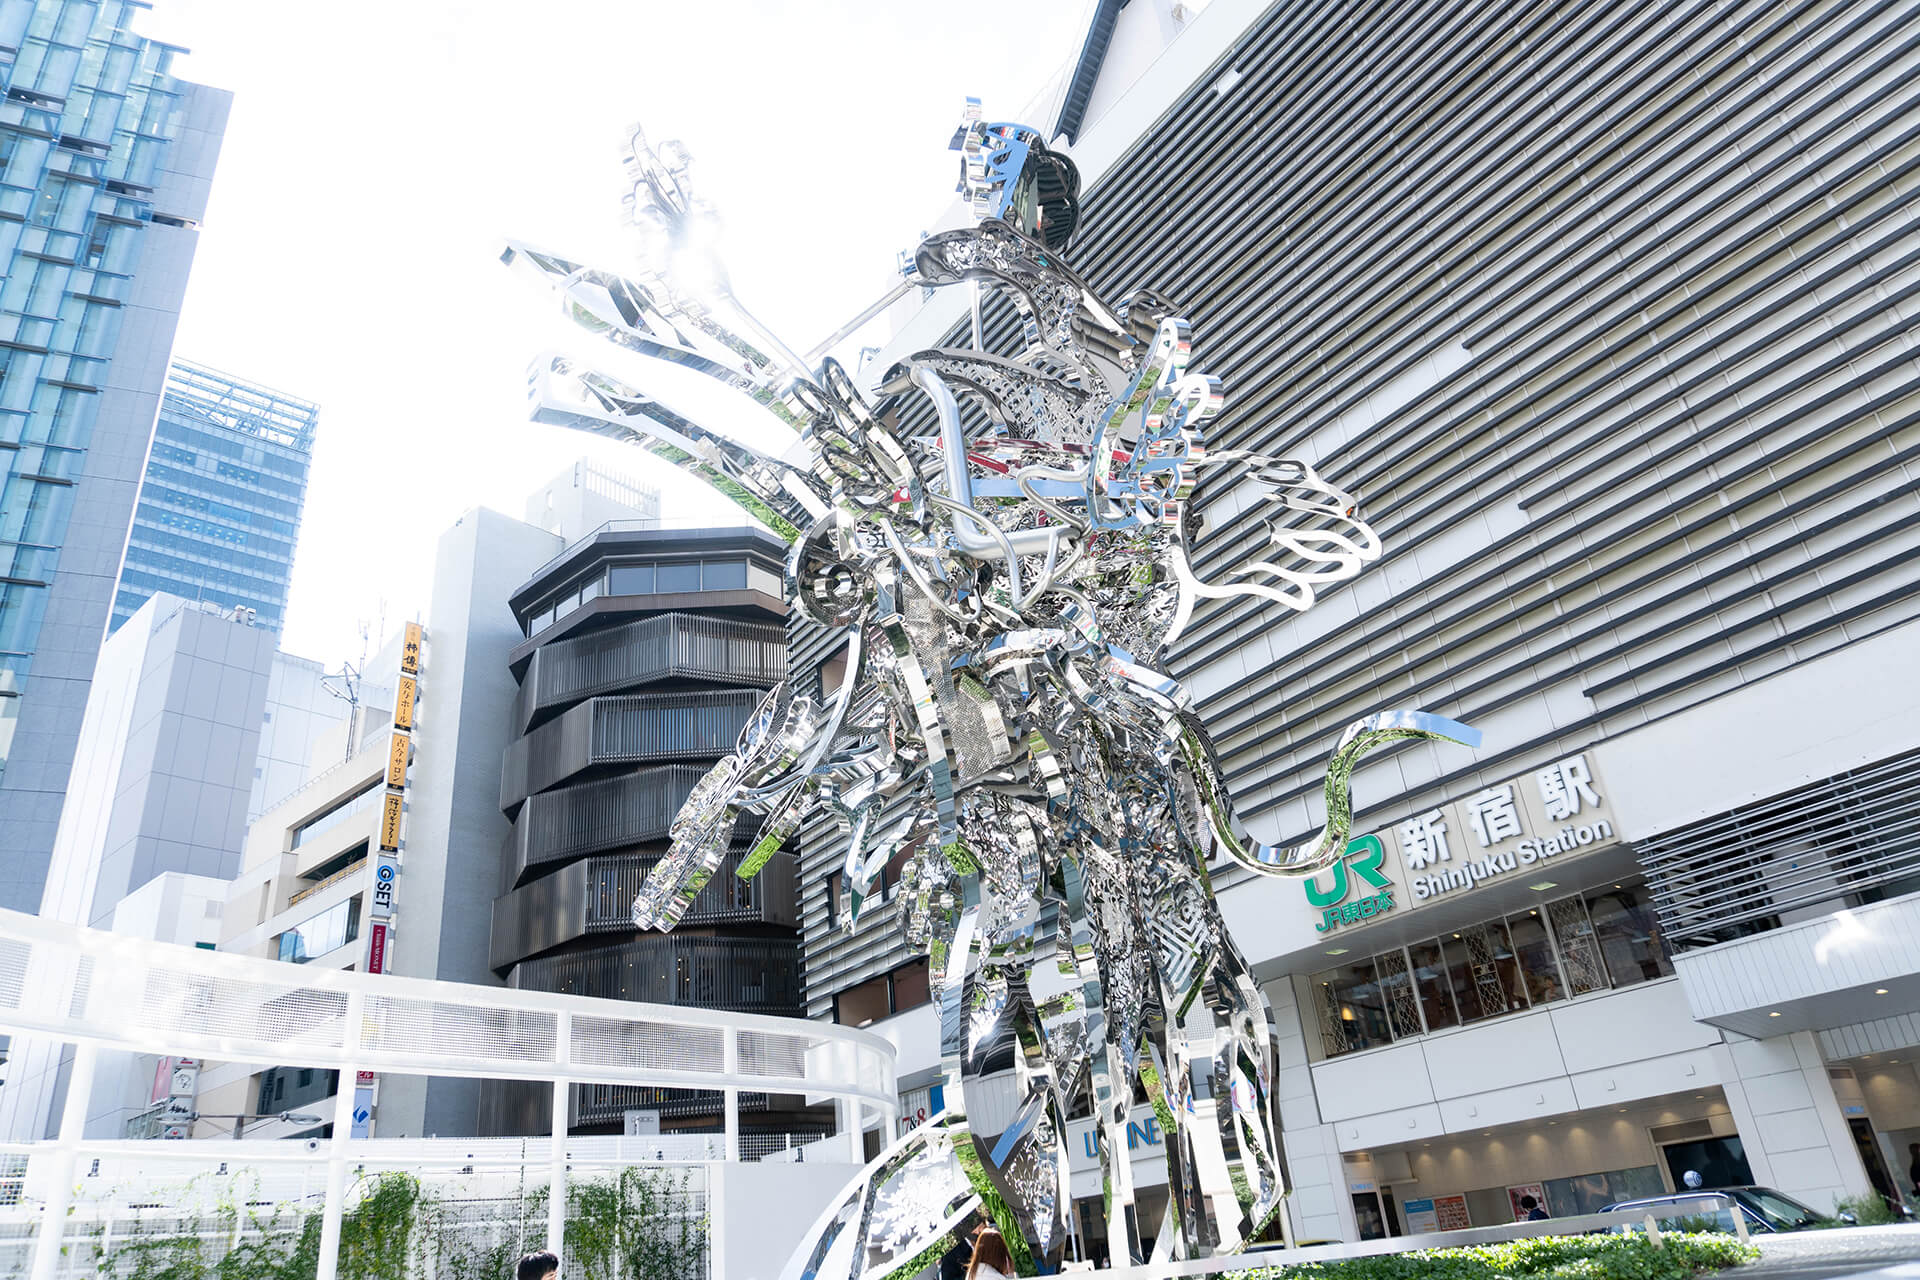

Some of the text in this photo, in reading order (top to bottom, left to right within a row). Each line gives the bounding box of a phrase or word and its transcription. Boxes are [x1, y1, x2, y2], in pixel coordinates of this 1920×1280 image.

[1400, 754, 1601, 870] 新宿駅
[1304, 834, 1393, 908] JR
[1413, 819, 1615, 900] Shinjuku Station
[1315, 890, 1395, 932] JR東日本
